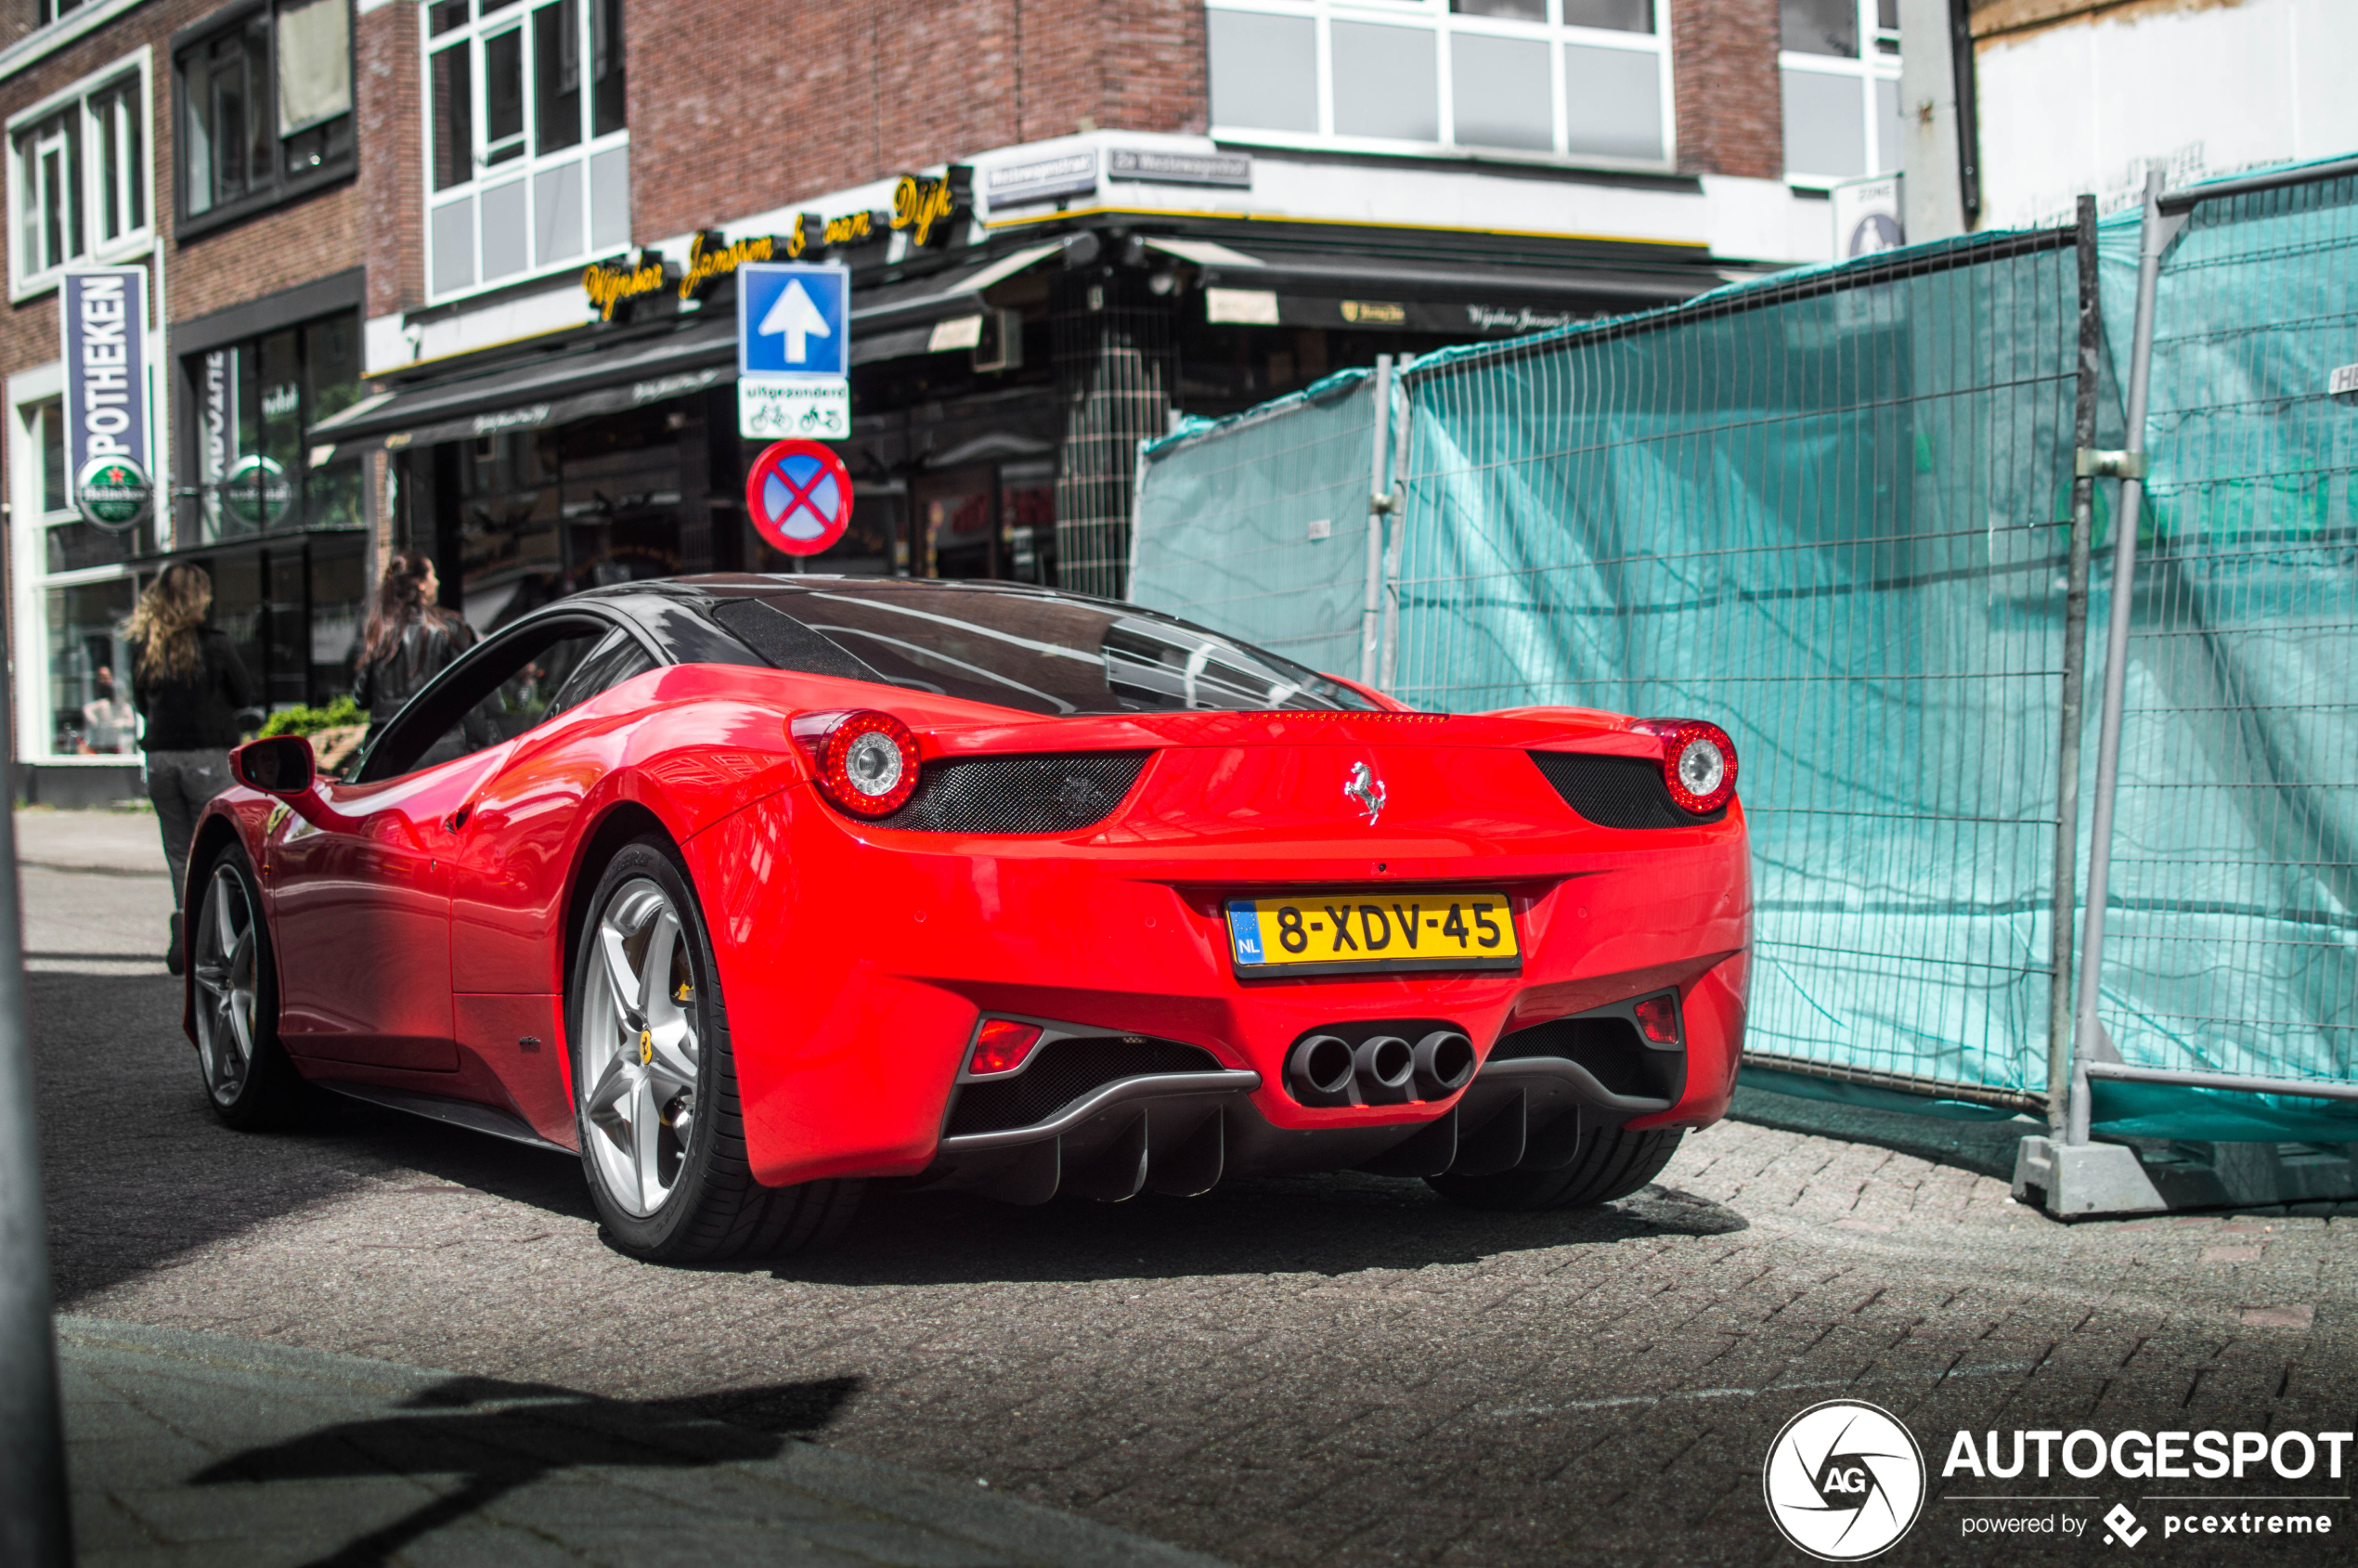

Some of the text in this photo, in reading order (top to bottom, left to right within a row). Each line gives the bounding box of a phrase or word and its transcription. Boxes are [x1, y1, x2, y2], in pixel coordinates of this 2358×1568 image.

[582, 171, 952, 322] Wijnbar Janssen & van Dijk
[80, 276, 132, 460] POTHEKEN
[746, 385, 847, 402] uitgezonderd
[1238, 939, 1261, 954] NL
[1277, 902, 1501, 953] 8-XDV-45
